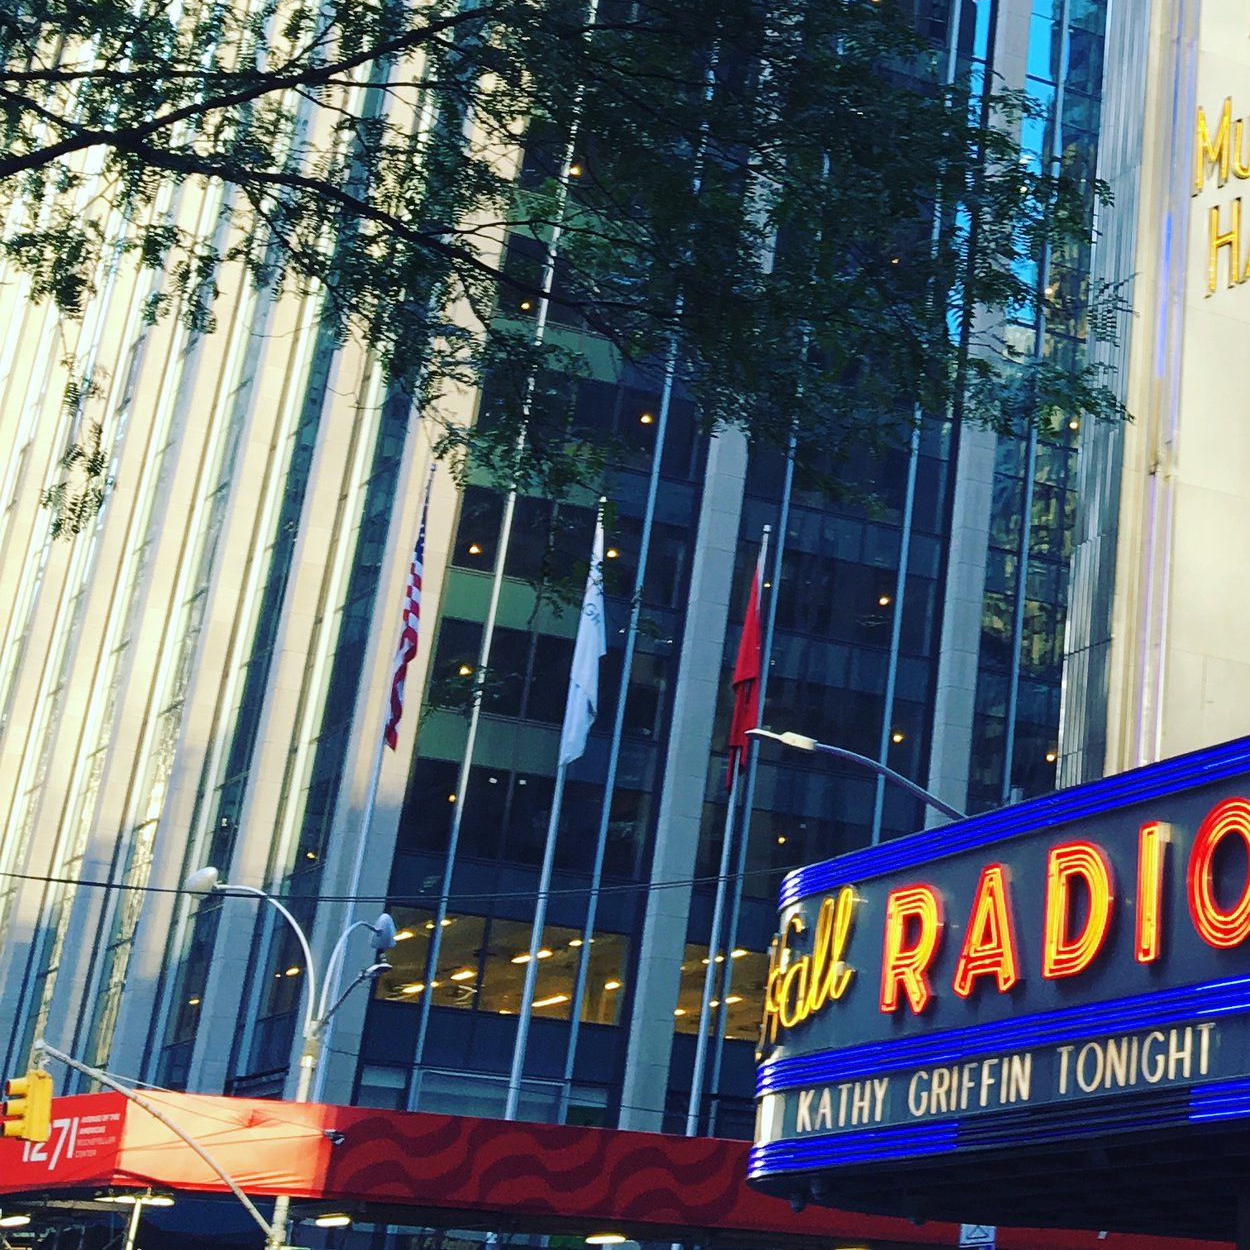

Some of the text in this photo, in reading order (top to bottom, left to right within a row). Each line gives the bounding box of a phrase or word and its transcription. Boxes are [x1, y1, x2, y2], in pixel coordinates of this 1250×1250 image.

[796, 1077, 888, 1133] KATHY
[908, 1053, 1031, 1117] GRIFFIN
[1057, 1022, 1216, 1095] TONIGHT
